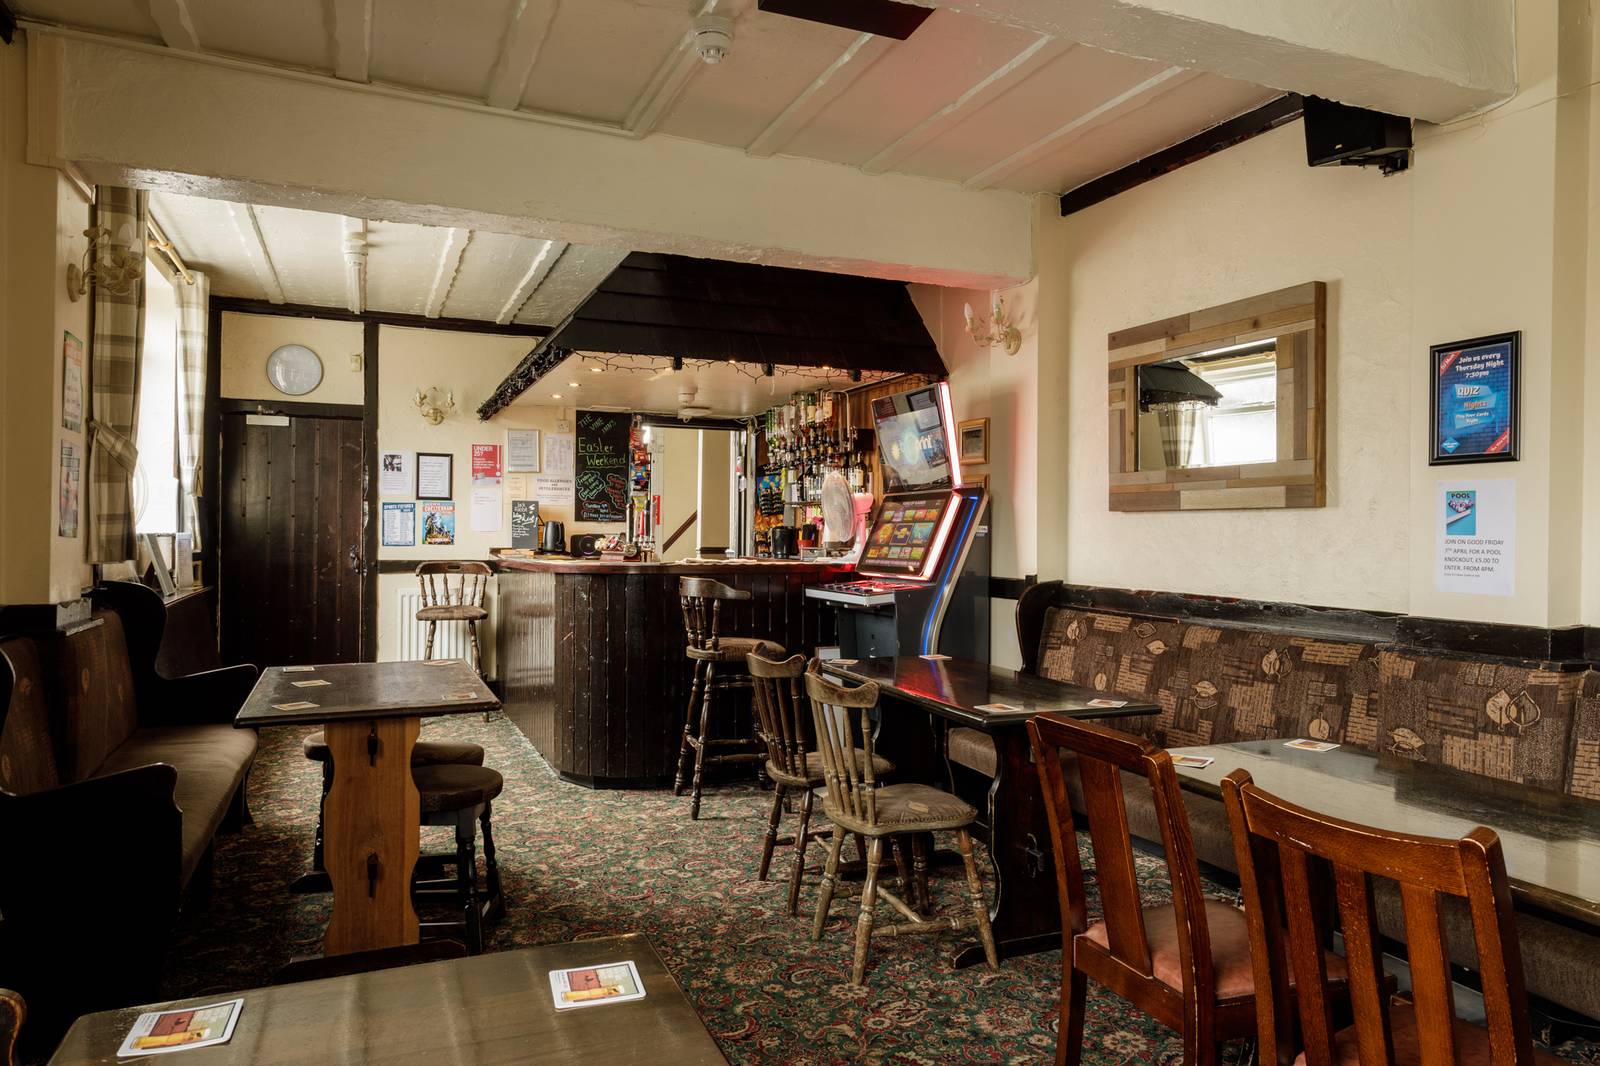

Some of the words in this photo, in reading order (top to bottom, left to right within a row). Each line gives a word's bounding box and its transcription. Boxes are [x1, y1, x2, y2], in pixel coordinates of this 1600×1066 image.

[1458, 355, 1472, 364] Join
[1481, 353, 1501, 362] every
[1456, 363, 1485, 372] Thursday
[1486, 360, 1504, 369] Night
[1457, 386, 1480, 397] QUIZ
[577, 413, 593, 428] THE
[590, 416, 605, 431] VINE
[578, 437, 613, 453] Easter
[586, 453, 626, 466] Weekend
